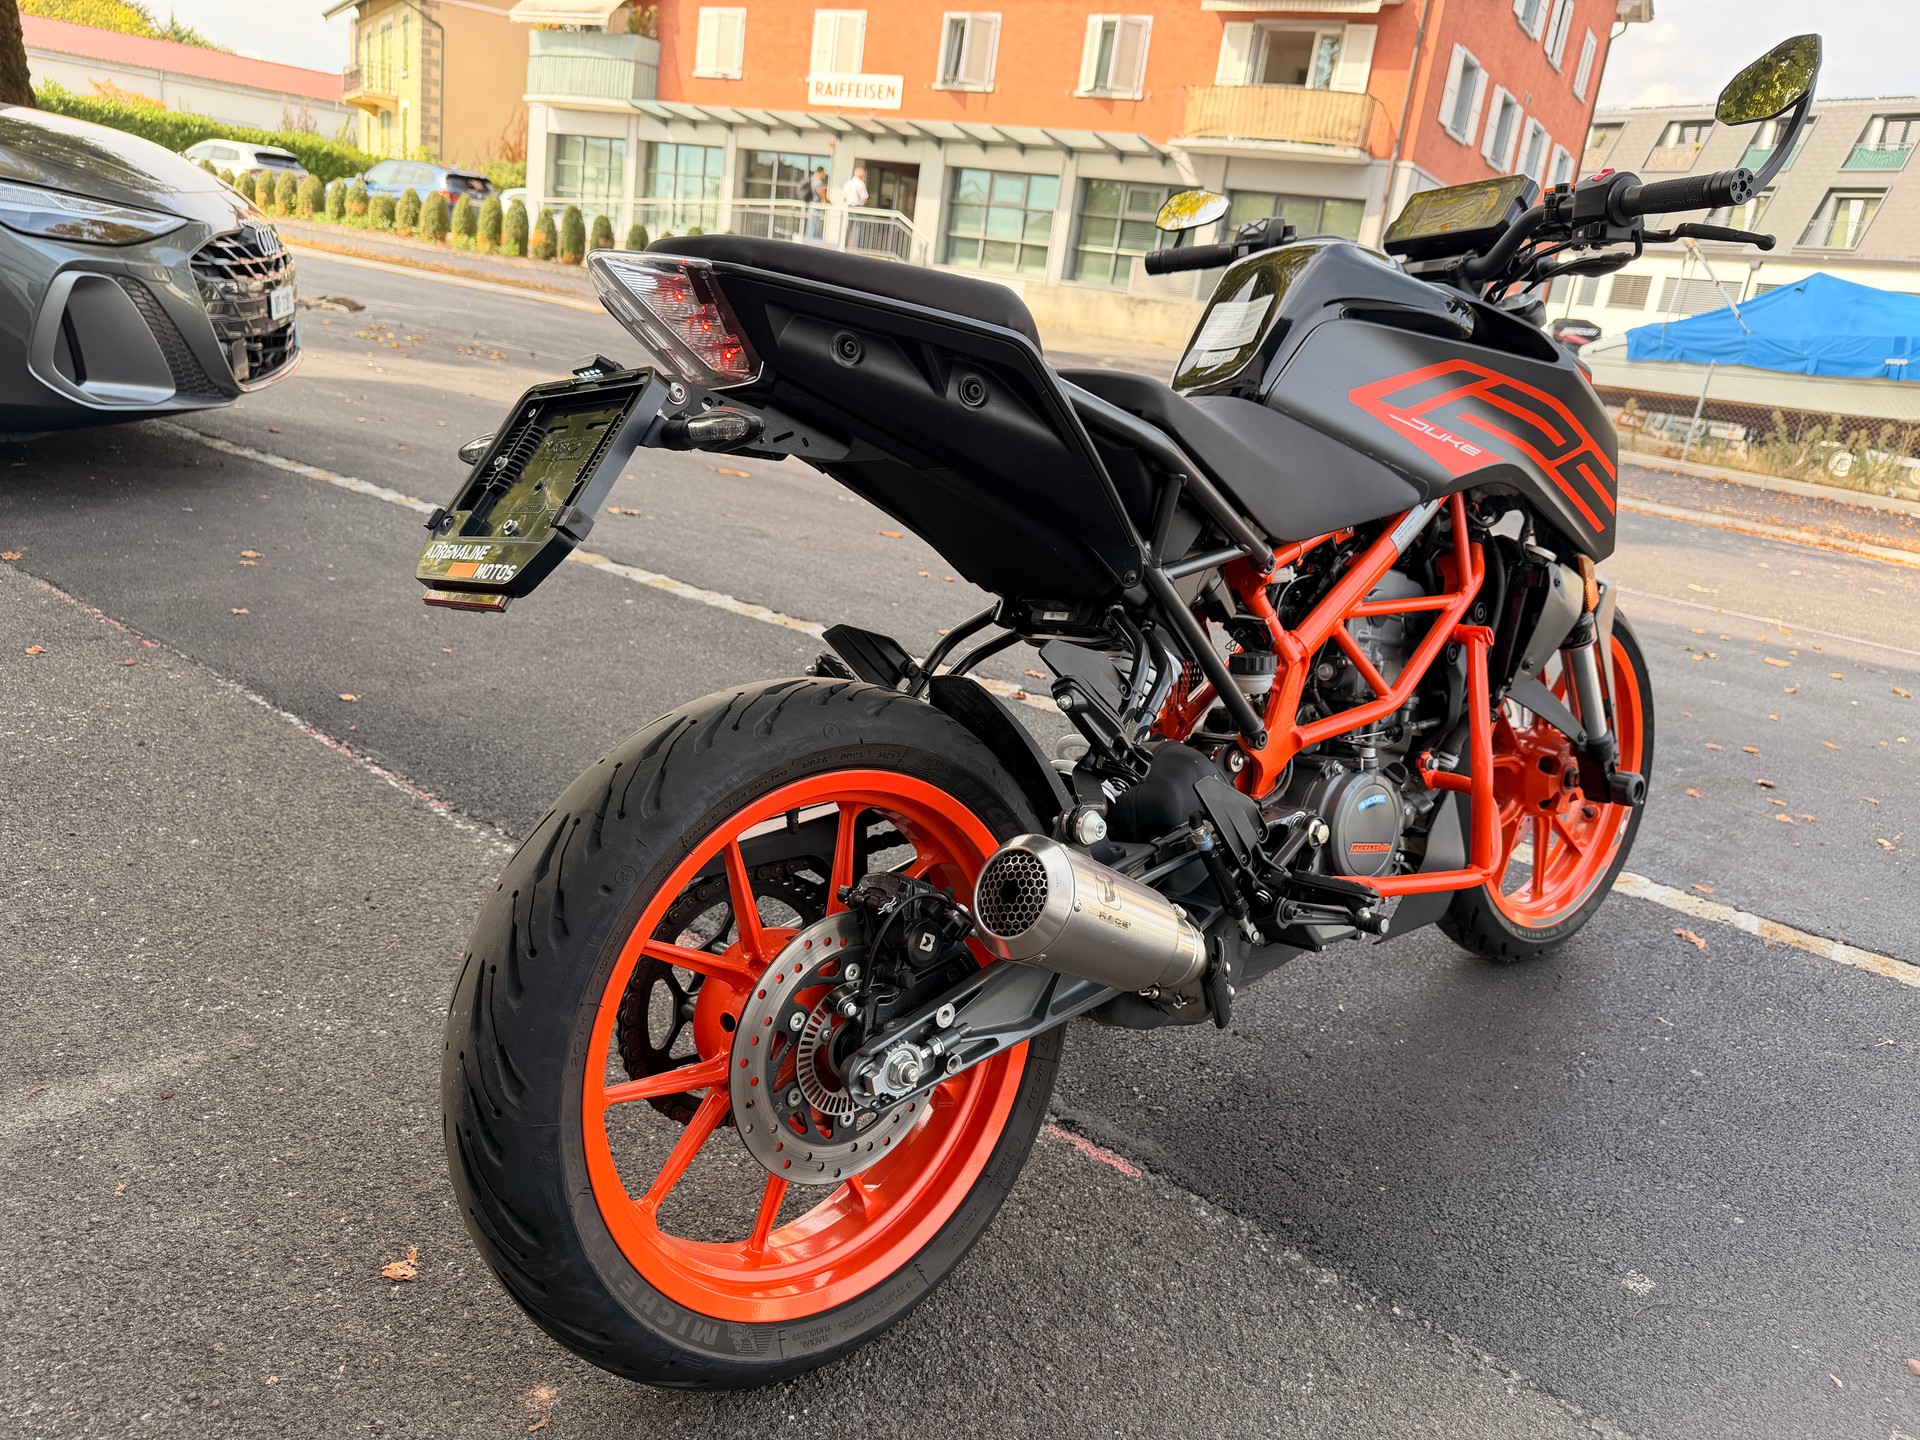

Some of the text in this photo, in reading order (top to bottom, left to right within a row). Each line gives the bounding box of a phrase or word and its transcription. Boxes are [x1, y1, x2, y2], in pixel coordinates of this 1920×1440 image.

[815, 81, 896, 100] RAIFFEISEN
[1388, 413, 1482, 457] DUKE
[423, 544, 491, 560] ADRENALINE
[473, 563, 517, 580] MOTOS
